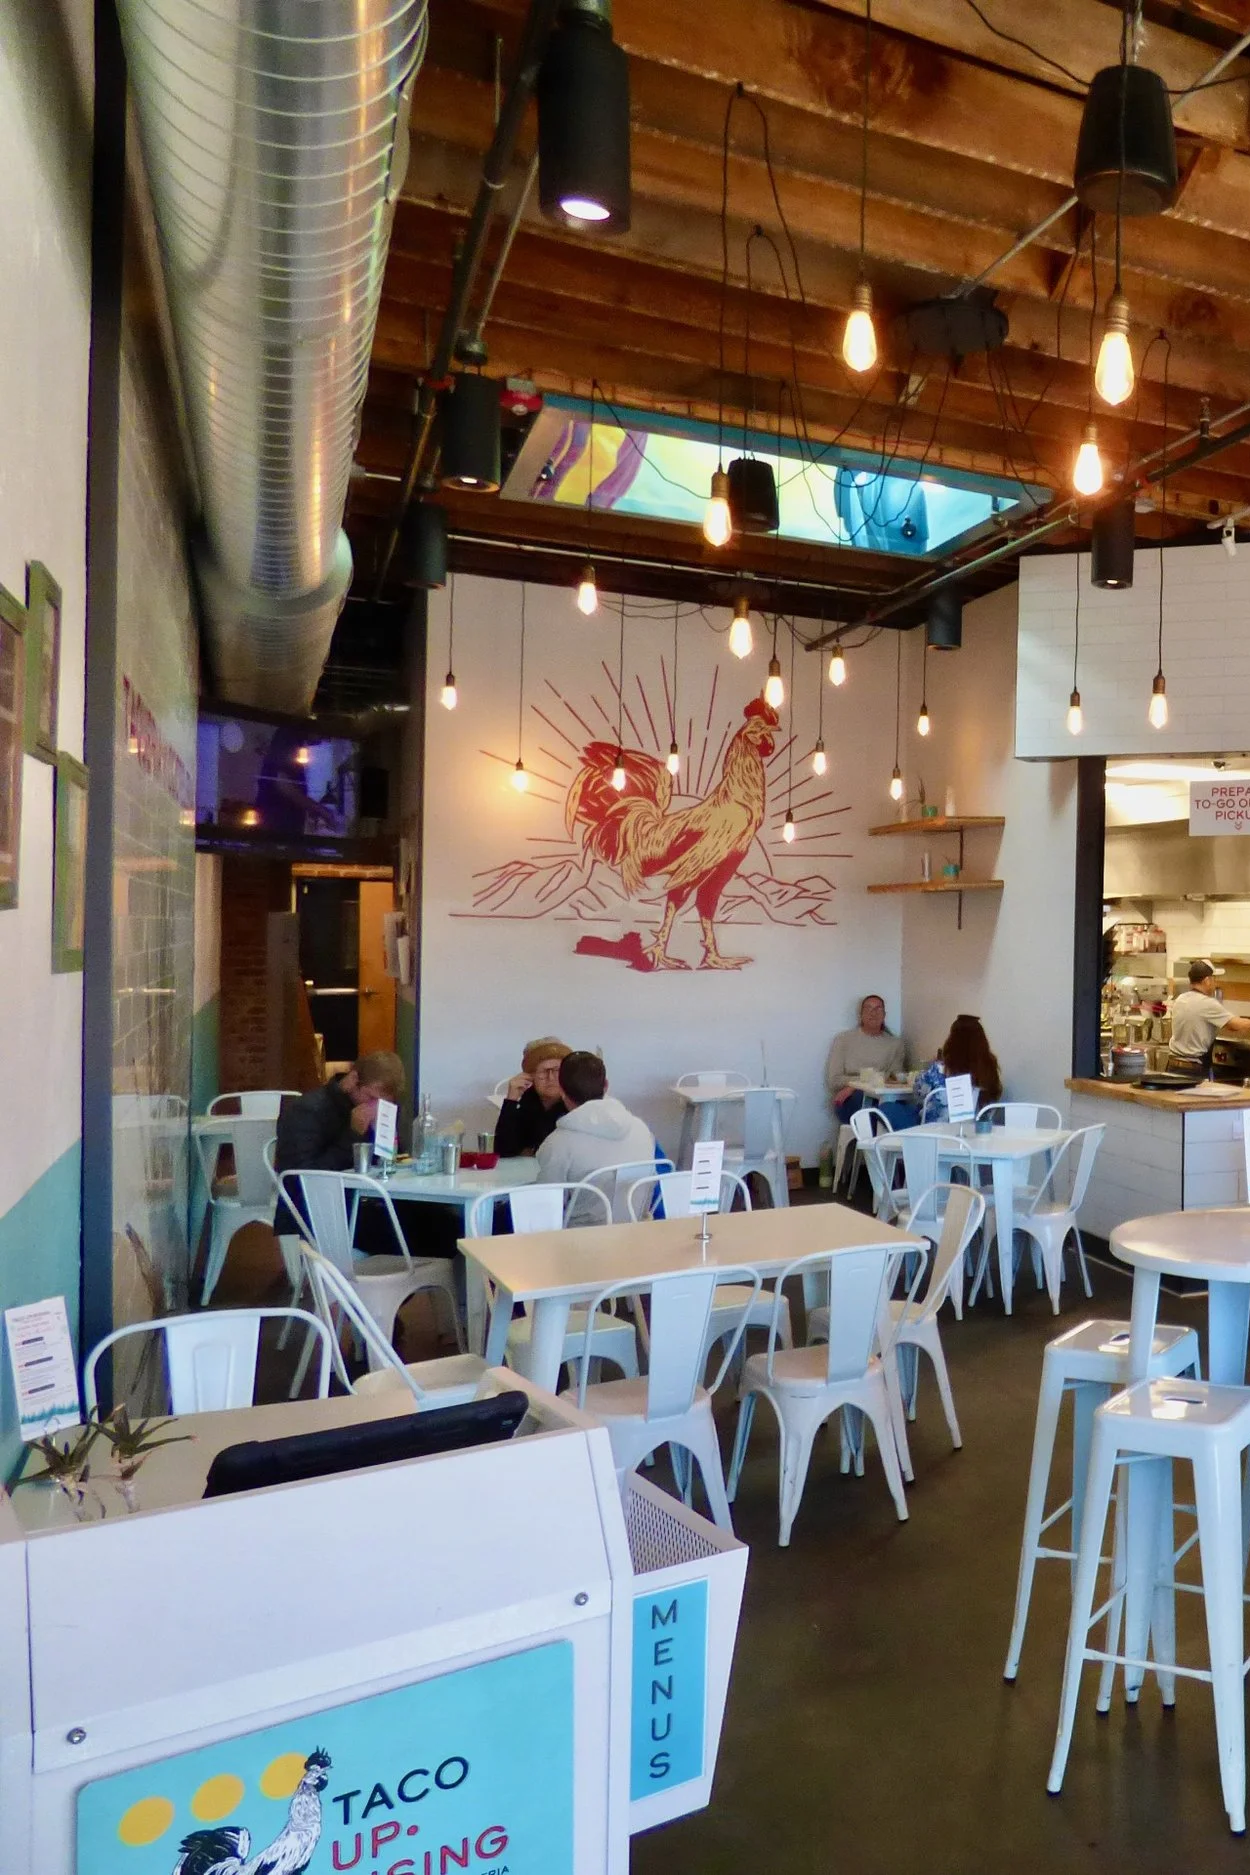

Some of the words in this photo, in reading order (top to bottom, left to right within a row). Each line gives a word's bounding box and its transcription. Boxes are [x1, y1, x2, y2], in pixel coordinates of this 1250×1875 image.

[1195, 799, 1235, 809] TO-GO
[650, 1598, 678, 1779] MENUS
[332, 1756, 469, 1825] TACO
